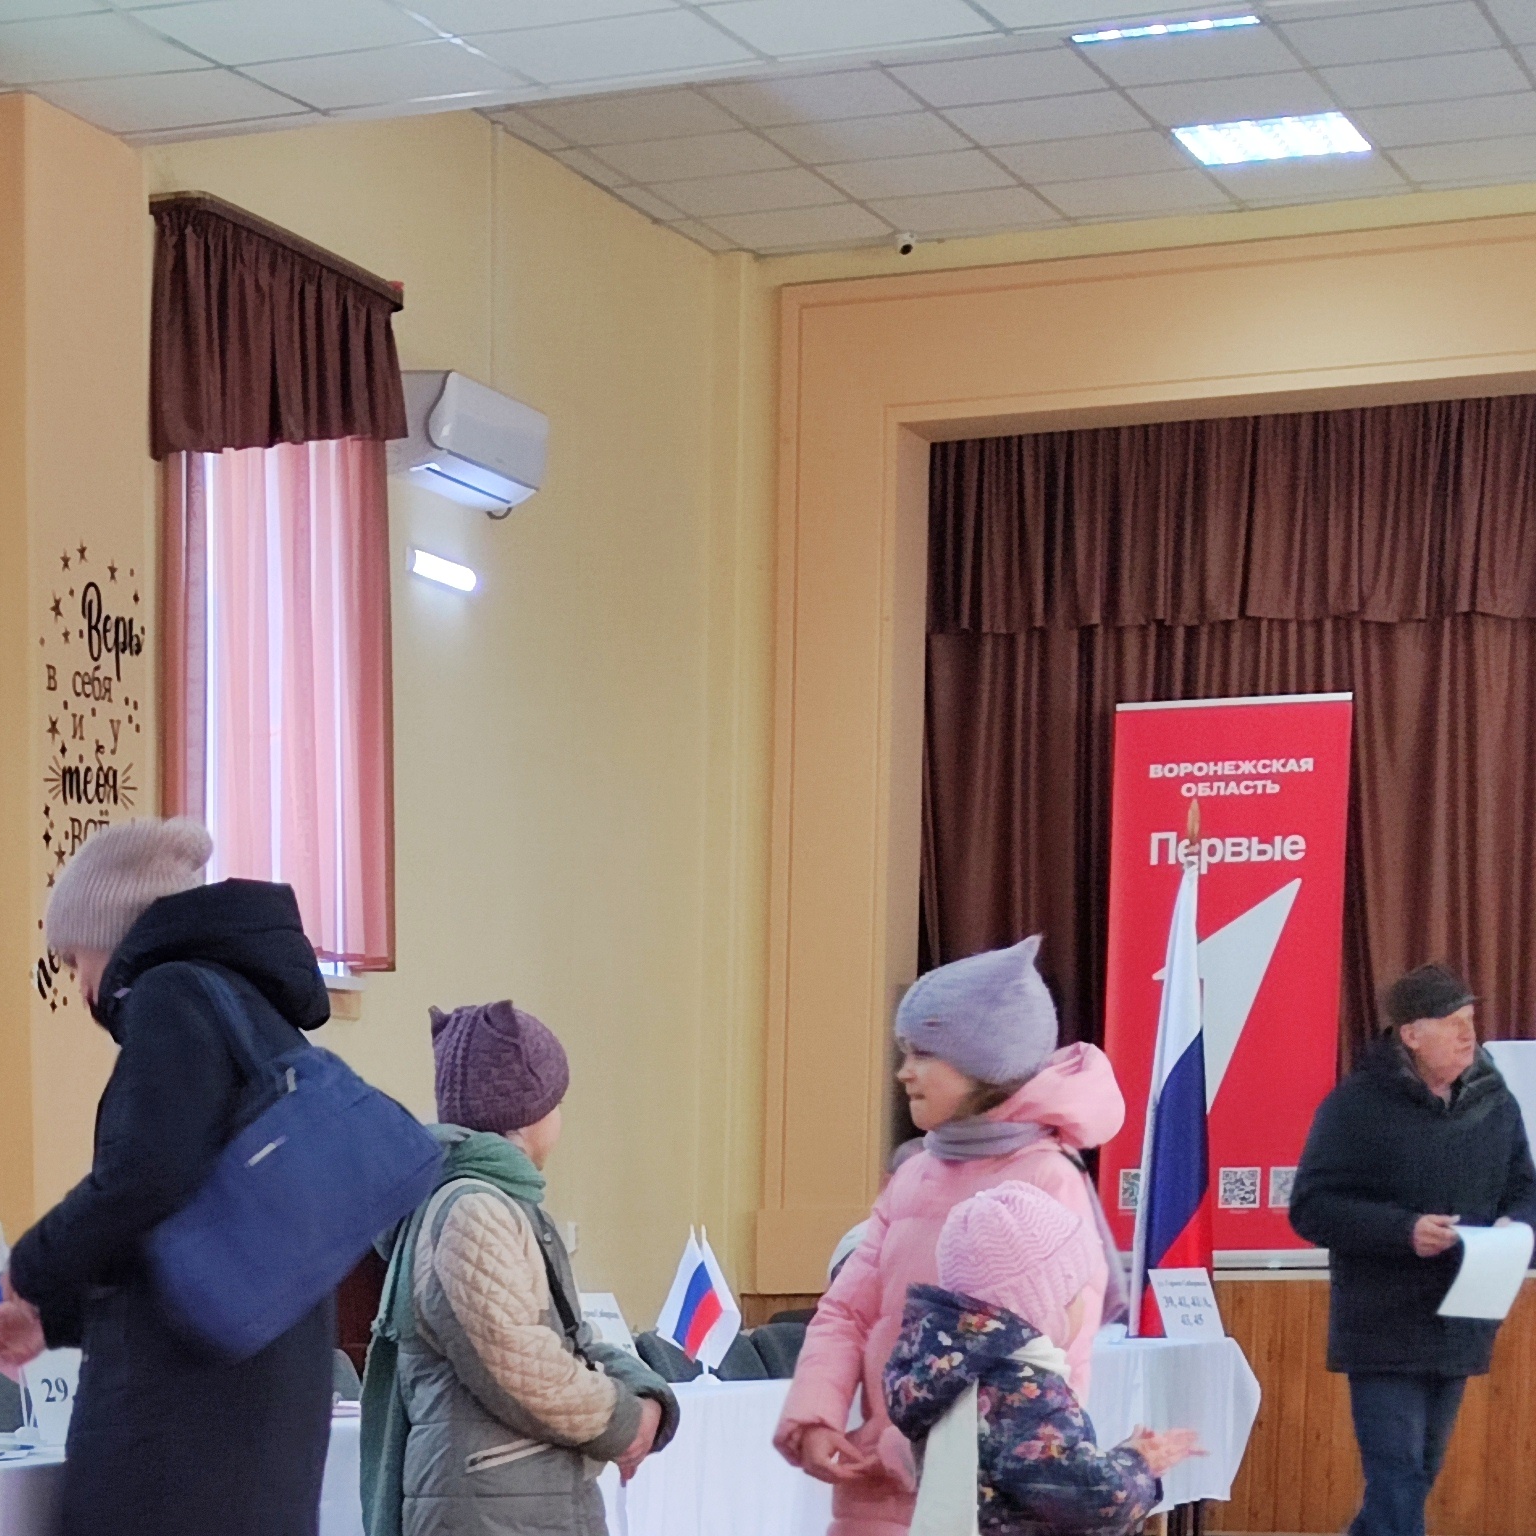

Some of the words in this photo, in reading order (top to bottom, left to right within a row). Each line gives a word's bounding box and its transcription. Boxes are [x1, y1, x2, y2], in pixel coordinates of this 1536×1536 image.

[81, 581, 143, 682] Верь
[72, 664, 113, 704] себя
[61, 738, 119, 806] тебя
[1149, 757, 1315, 778] ВОРОНЕЖСКАЯ
[1181, 780, 1281, 798] ОБЛАСТЬ
[1149, 831, 1307, 874] Первые
[41, 1377, 69, 1403] 29
